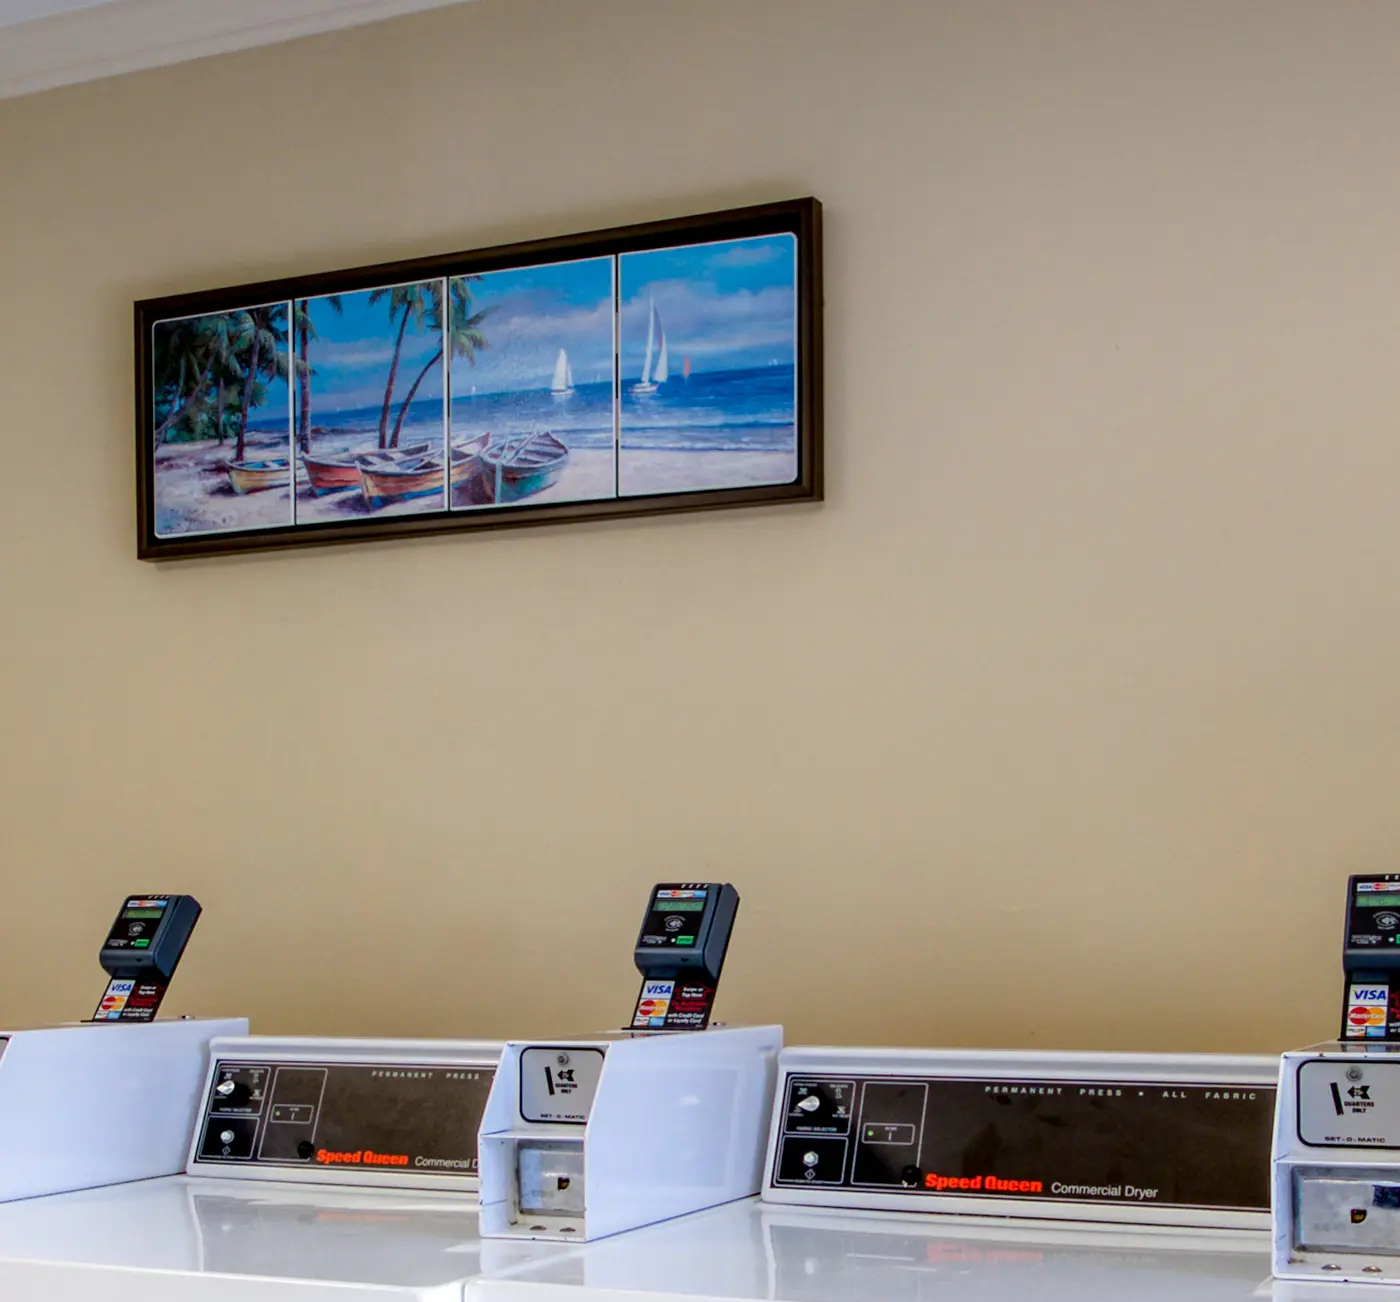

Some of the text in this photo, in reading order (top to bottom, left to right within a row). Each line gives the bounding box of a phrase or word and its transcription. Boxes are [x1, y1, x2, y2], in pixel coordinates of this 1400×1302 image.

[112, 984, 132, 992] VISA
[647, 985, 672, 994] VISA
[1352, 990, 1386, 1000] VISA
[371, 1070, 480, 1080] PERMANENT PRESS
[984, 1085, 1257, 1101] PERMANENT PRESS ALL FABRIC
[316, 1149, 361, 1165] Speed
[363, 1151, 409, 1166] Queen
[414, 1156, 470, 1168] Commercial
[925, 1173, 1159, 1201] Speed Queen Commercial Dryer
